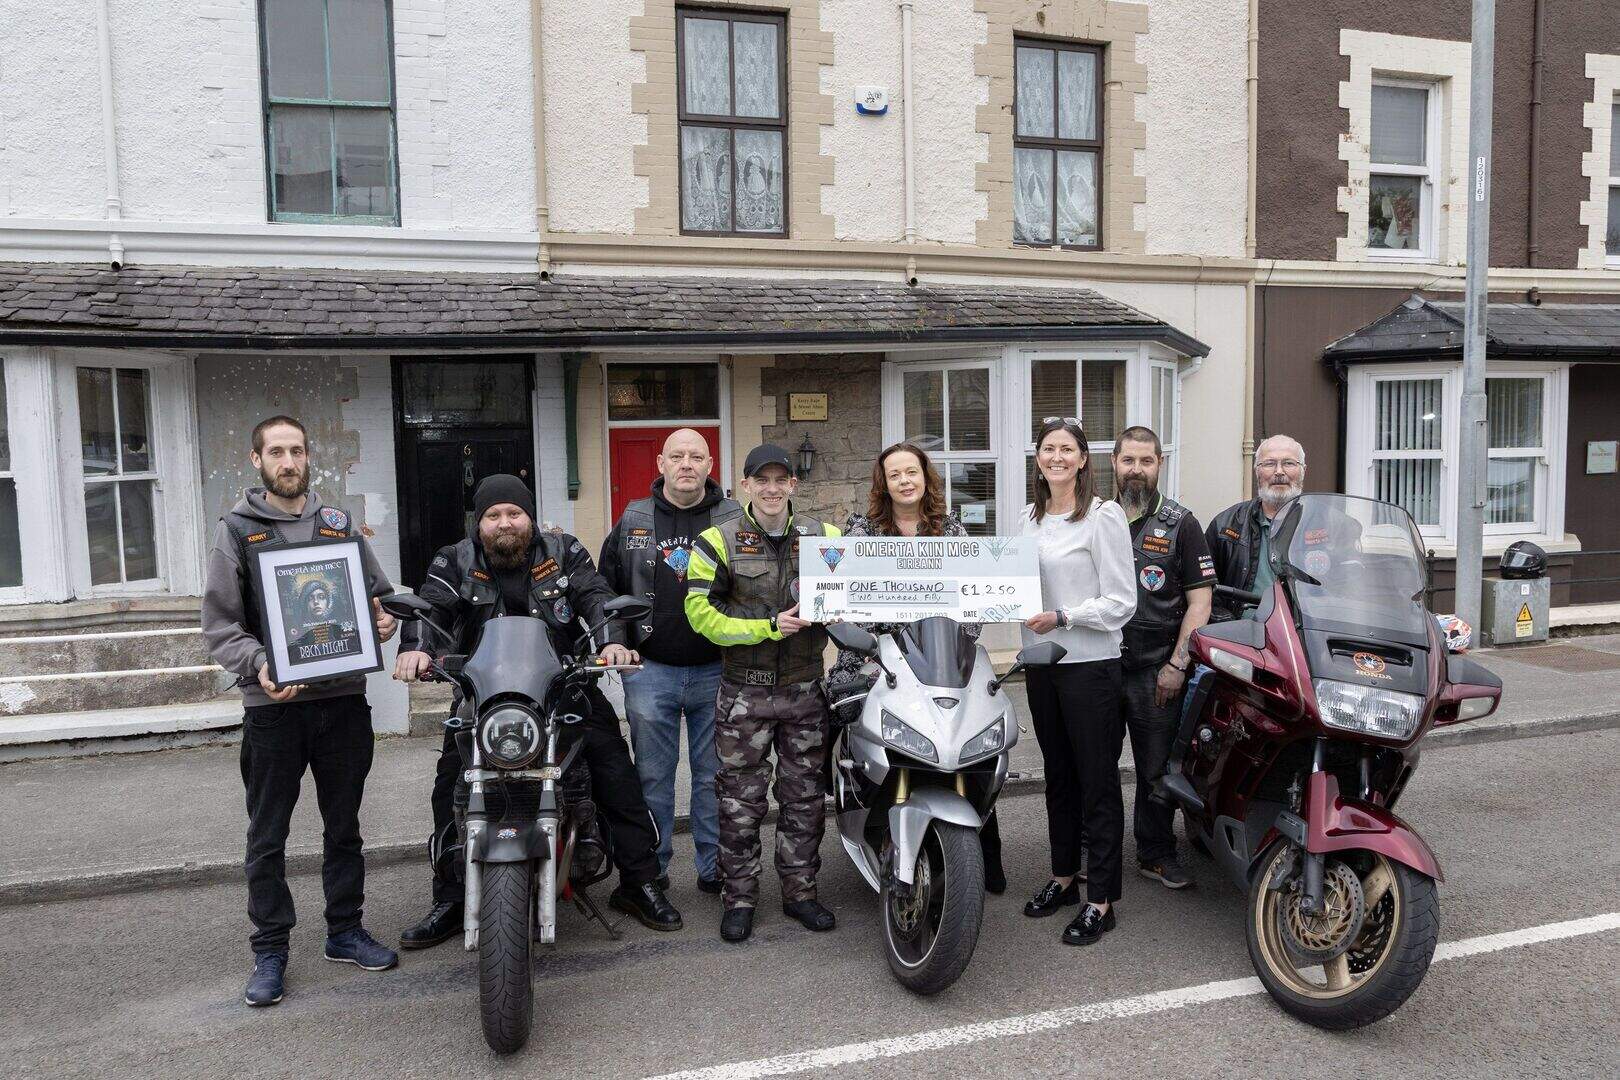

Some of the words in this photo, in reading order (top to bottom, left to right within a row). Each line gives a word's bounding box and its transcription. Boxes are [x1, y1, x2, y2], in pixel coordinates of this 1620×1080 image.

[463, 444, 472, 456] 6
[248, 533, 267, 542] KERRY
[854, 541, 914, 557] OMERTA
[918, 541, 944, 557] KIN
[947, 541, 980, 557] MCC
[897, 558, 943, 569] EIREANN
[816, 582, 844, 591] AMOUNT
[849, 581, 878, 592] ONE
[883, 580, 945, 593] THOUSAND
[322, 639, 349, 655] NIGHT
[1355, 669, 1393, 681] HONDA
